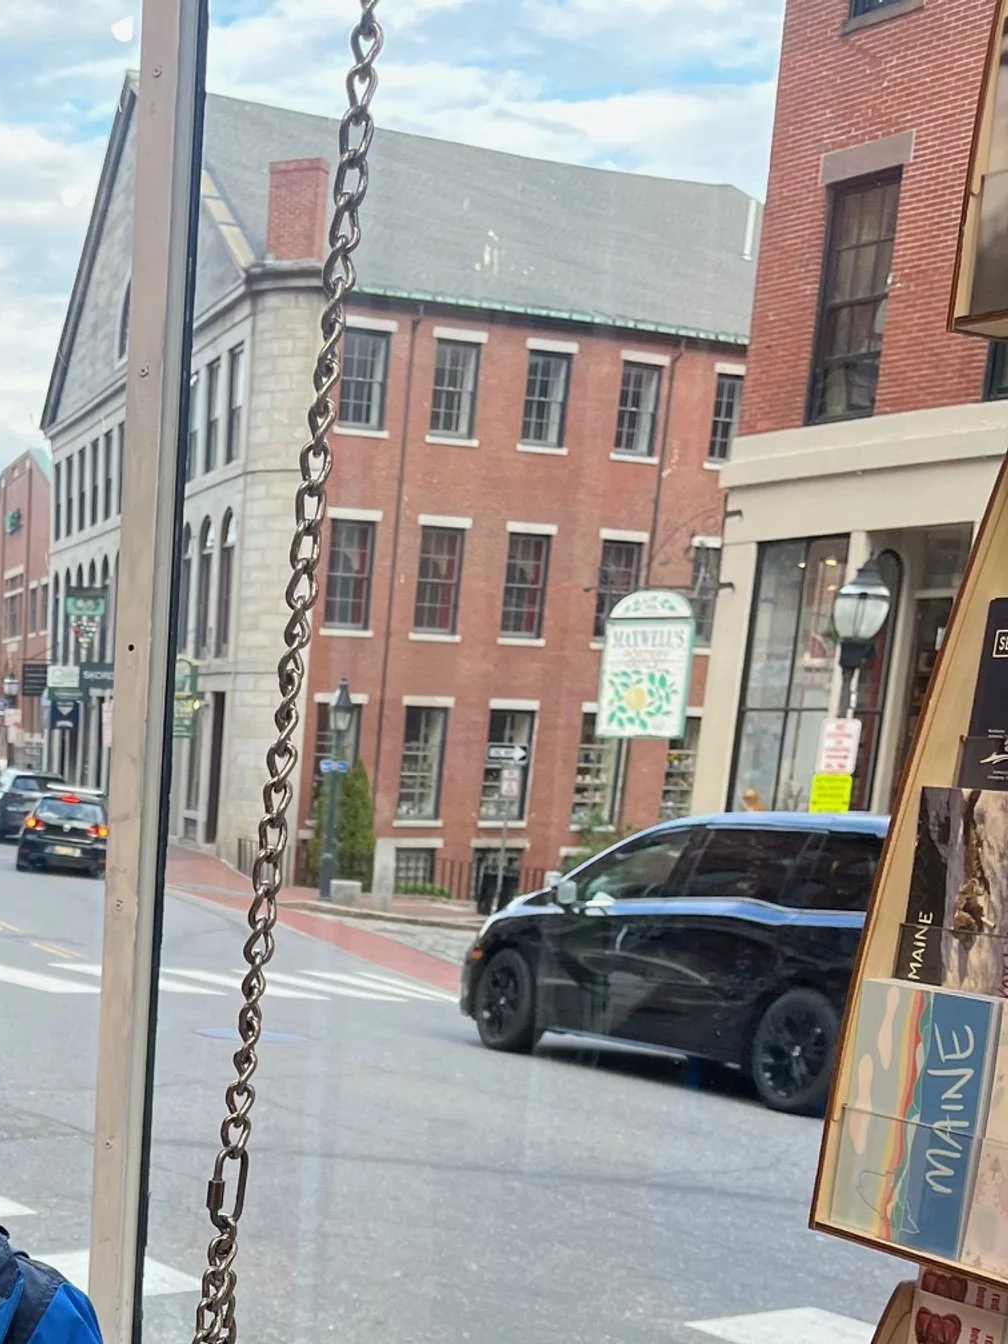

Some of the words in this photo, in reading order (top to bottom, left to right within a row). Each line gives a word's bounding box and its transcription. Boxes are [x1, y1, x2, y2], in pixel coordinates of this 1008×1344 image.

[611, 629, 685, 648] MAXWELL'S
[907, 911, 934, 980] MAINE
[925, 1022, 976, 1194] MAINE
